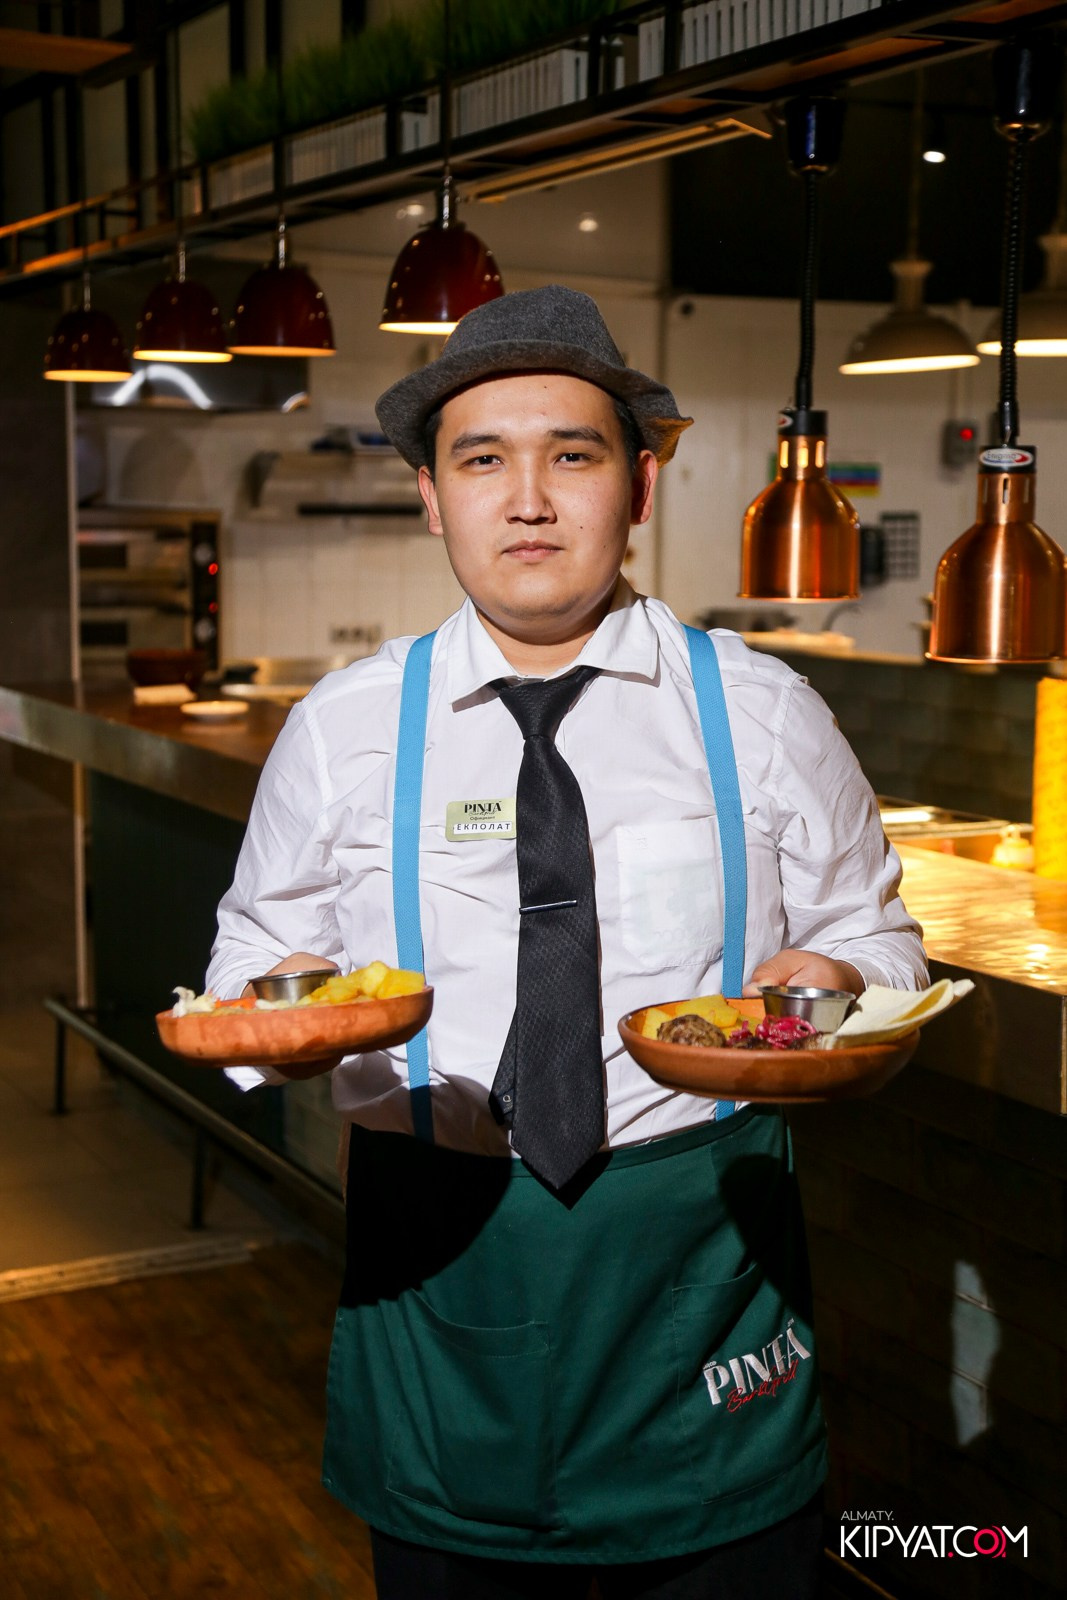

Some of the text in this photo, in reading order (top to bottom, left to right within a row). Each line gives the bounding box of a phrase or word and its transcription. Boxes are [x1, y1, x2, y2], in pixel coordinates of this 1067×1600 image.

[464, 802, 502, 814] PINTA
[453, 823, 511, 831] ЕКПОЛАТ
[703, 1327, 812, 1406] PINTA
